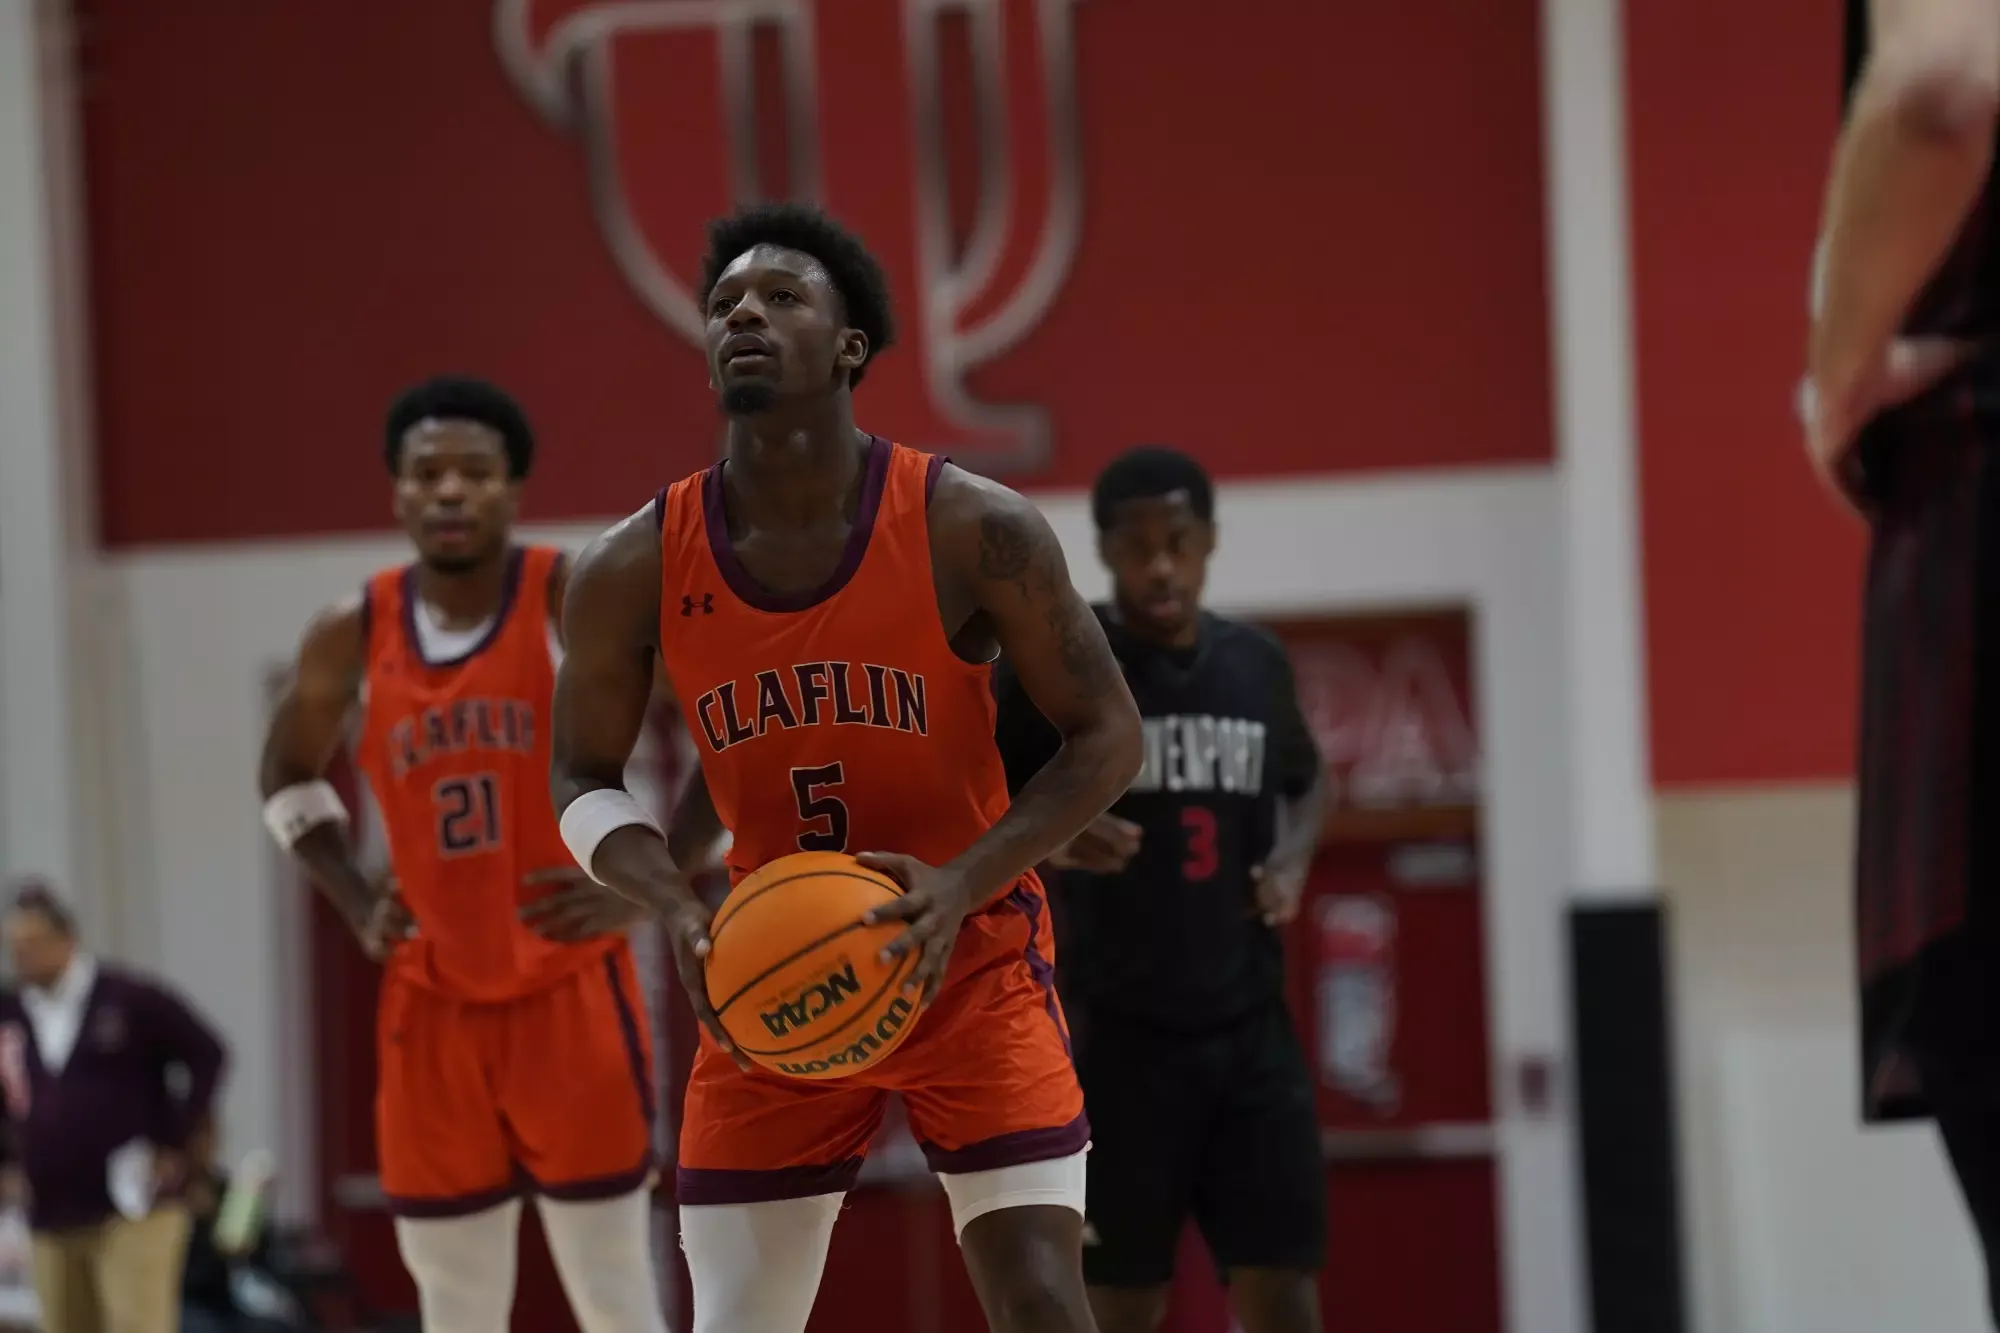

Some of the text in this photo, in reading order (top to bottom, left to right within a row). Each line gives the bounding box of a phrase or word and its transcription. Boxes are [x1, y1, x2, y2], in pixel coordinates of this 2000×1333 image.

[696, 661, 928, 753] CLAFLIN
[1127, 713, 1266, 798] VENPORT
[433, 770, 502, 859] 21
[790, 761, 848, 852] 5
[1180, 805, 1219, 882] 3
[758, 961, 863, 1039] NCAA
[775, 996, 914, 1075] Wilson
